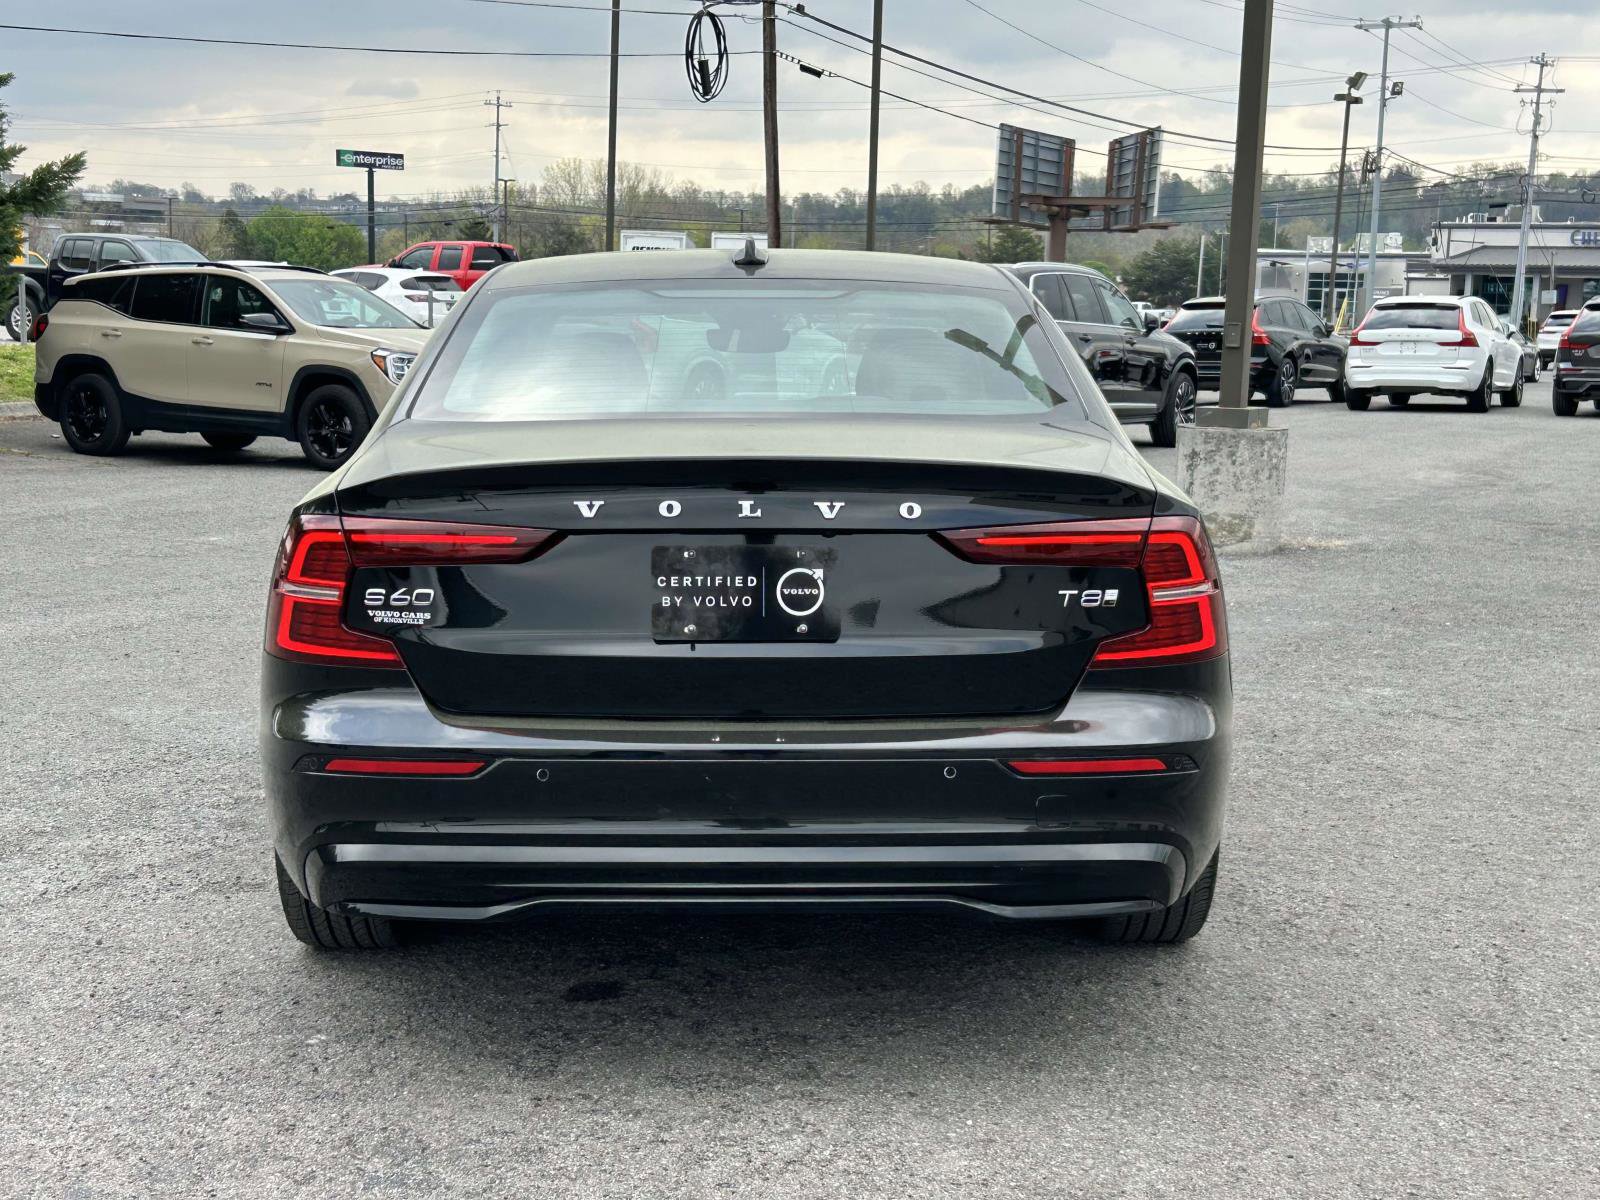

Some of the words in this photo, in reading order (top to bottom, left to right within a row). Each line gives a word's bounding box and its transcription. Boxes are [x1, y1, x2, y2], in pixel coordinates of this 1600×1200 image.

[341, 153, 404, 167] enterprise
[573, 500, 922, 519] VOLVO
[657, 576, 758, 587] CERTIFIED
[782, 587, 819, 595] VOLVO
[364, 588, 435, 606] S60
[662, 596, 683, 607] BY
[693, 596, 752, 607] VOLVO
[1058, 589, 1102, 607] T8
[367, 610, 400, 618] VOLVO
[401, 612, 431, 620] CARS
[383, 617, 424, 625] KNOXVILLE
